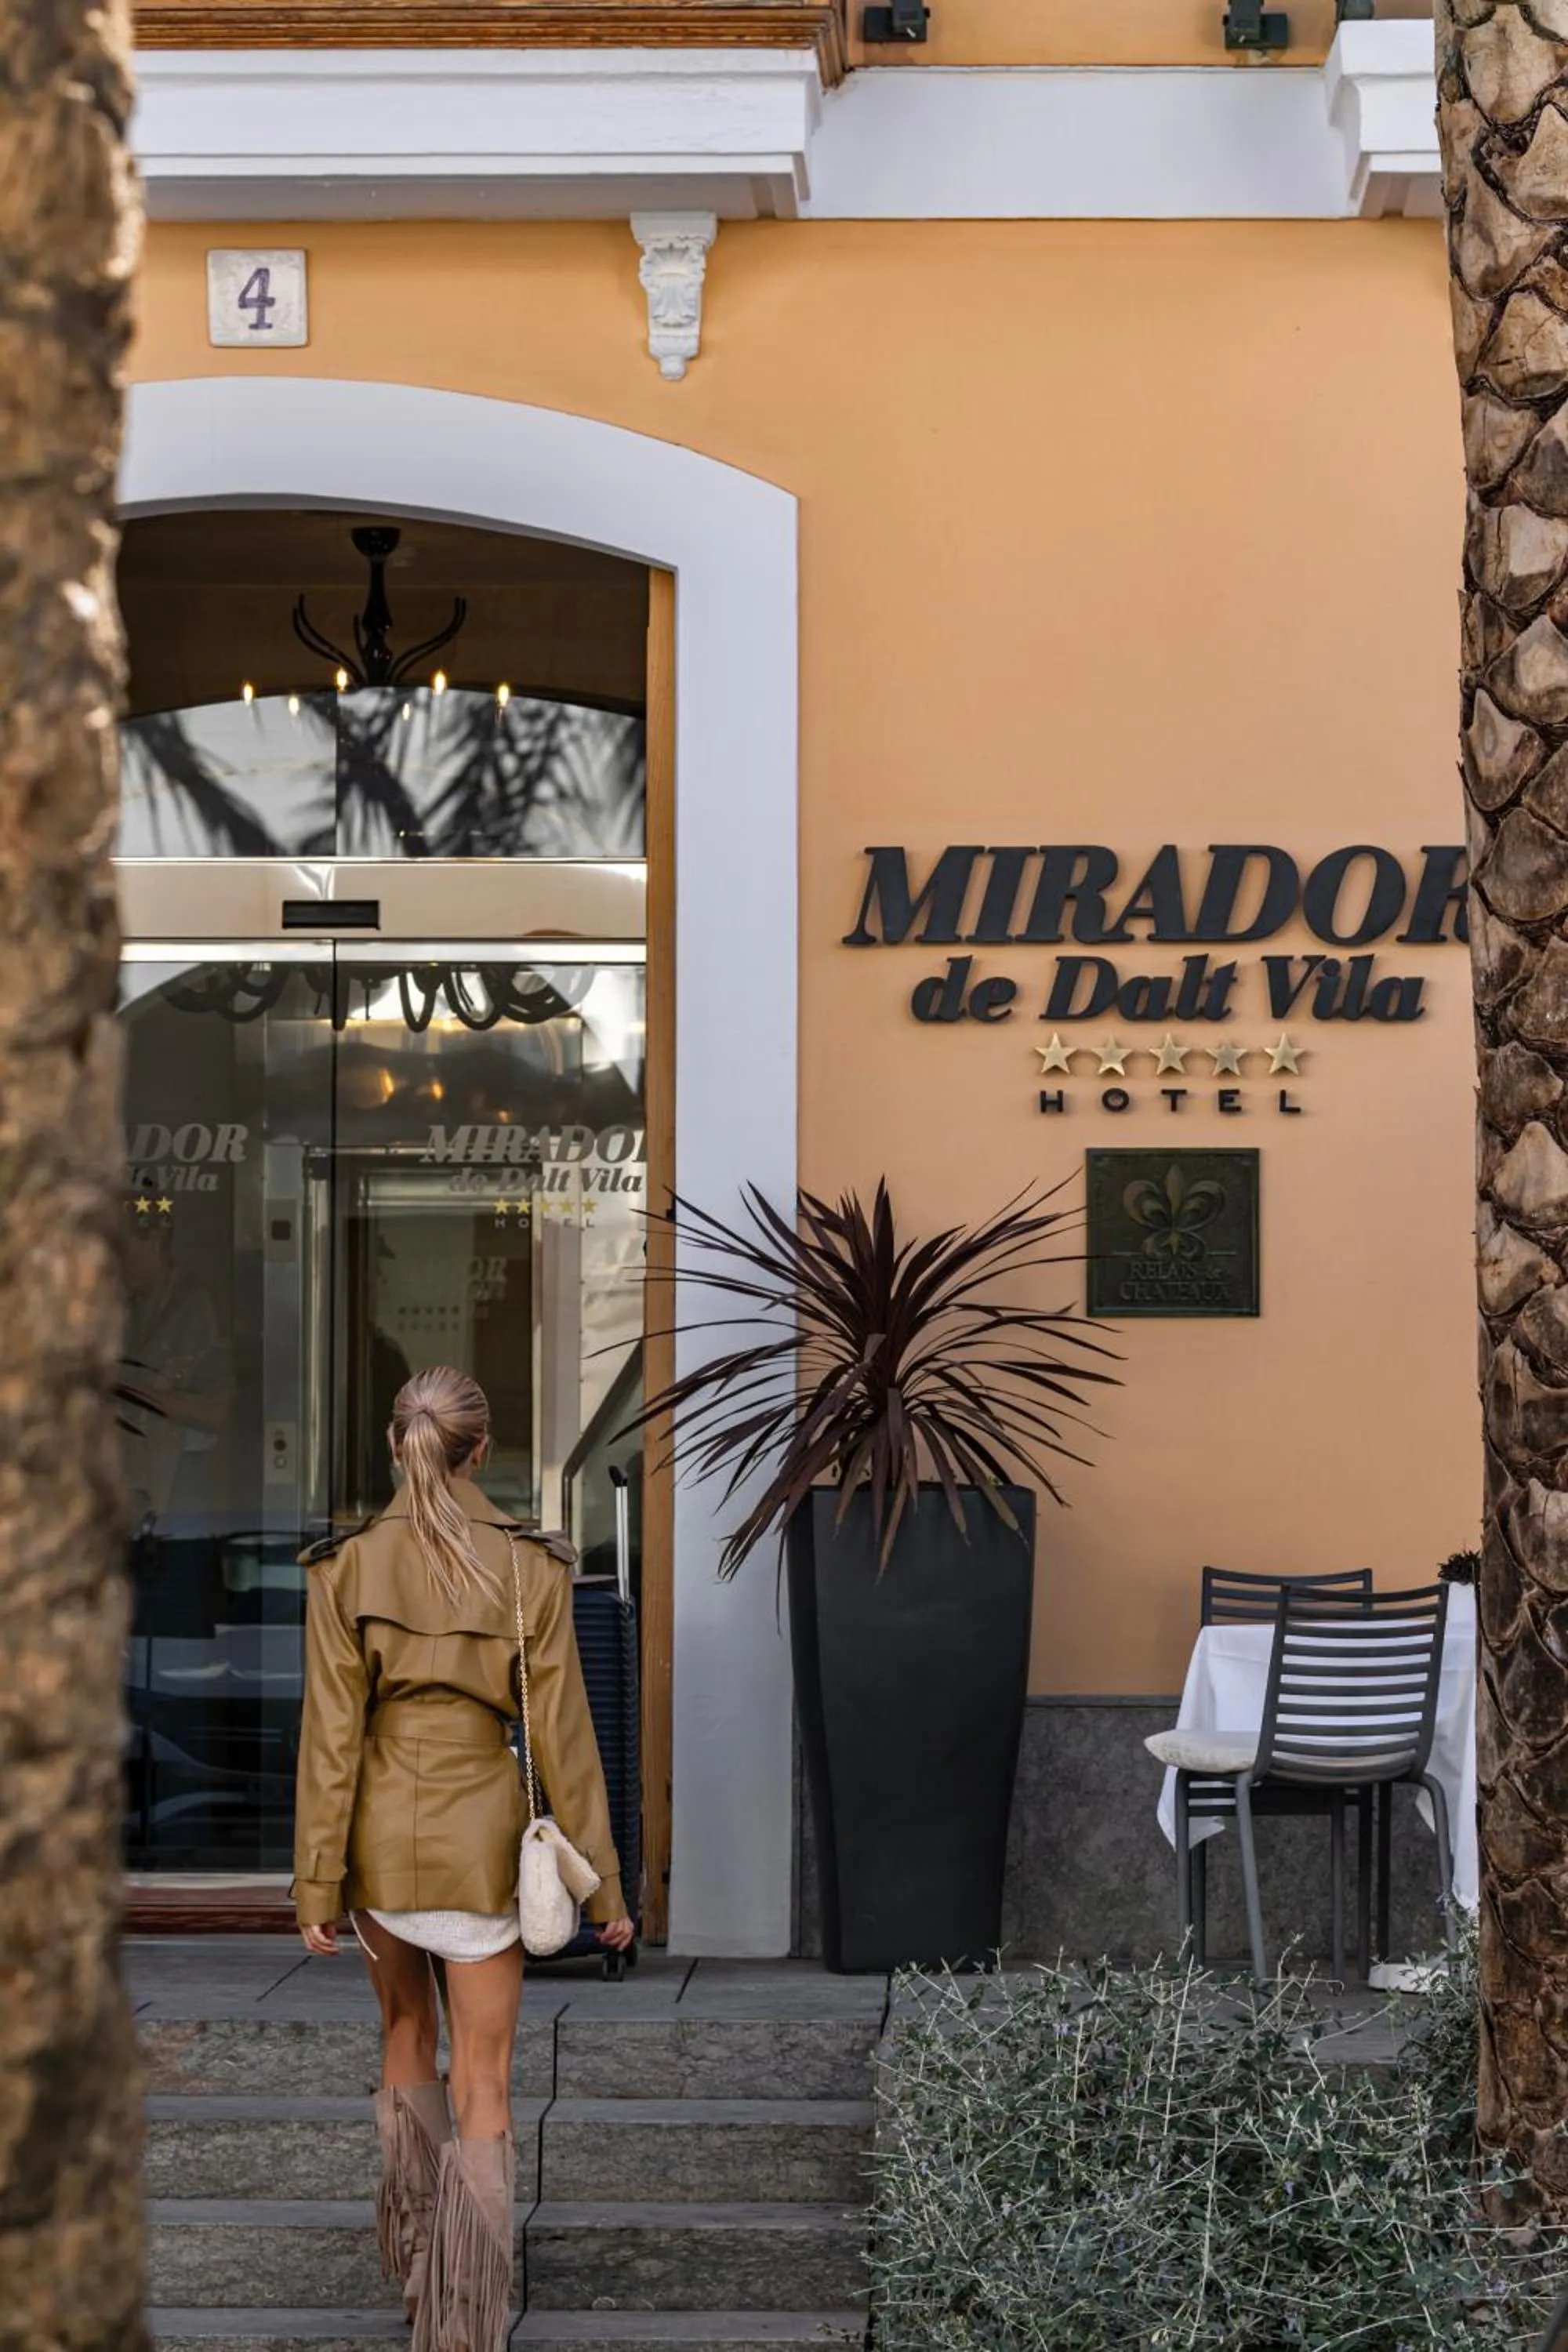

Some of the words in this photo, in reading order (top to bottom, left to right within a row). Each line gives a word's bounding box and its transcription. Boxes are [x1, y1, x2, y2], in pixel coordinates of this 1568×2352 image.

[238, 267, 277, 330] 4
[841, 844, 1471, 946] MIRADOR
[911, 954, 1017, 1022] de
[1038, 953, 1238, 1021] Dalt
[1261, 953, 1425, 1021] Vila
[1040, 1087, 1301, 1113] HOTEL
[496, 1167, 571, 1192] Dalt
[580, 1167, 642, 1192] Vila
